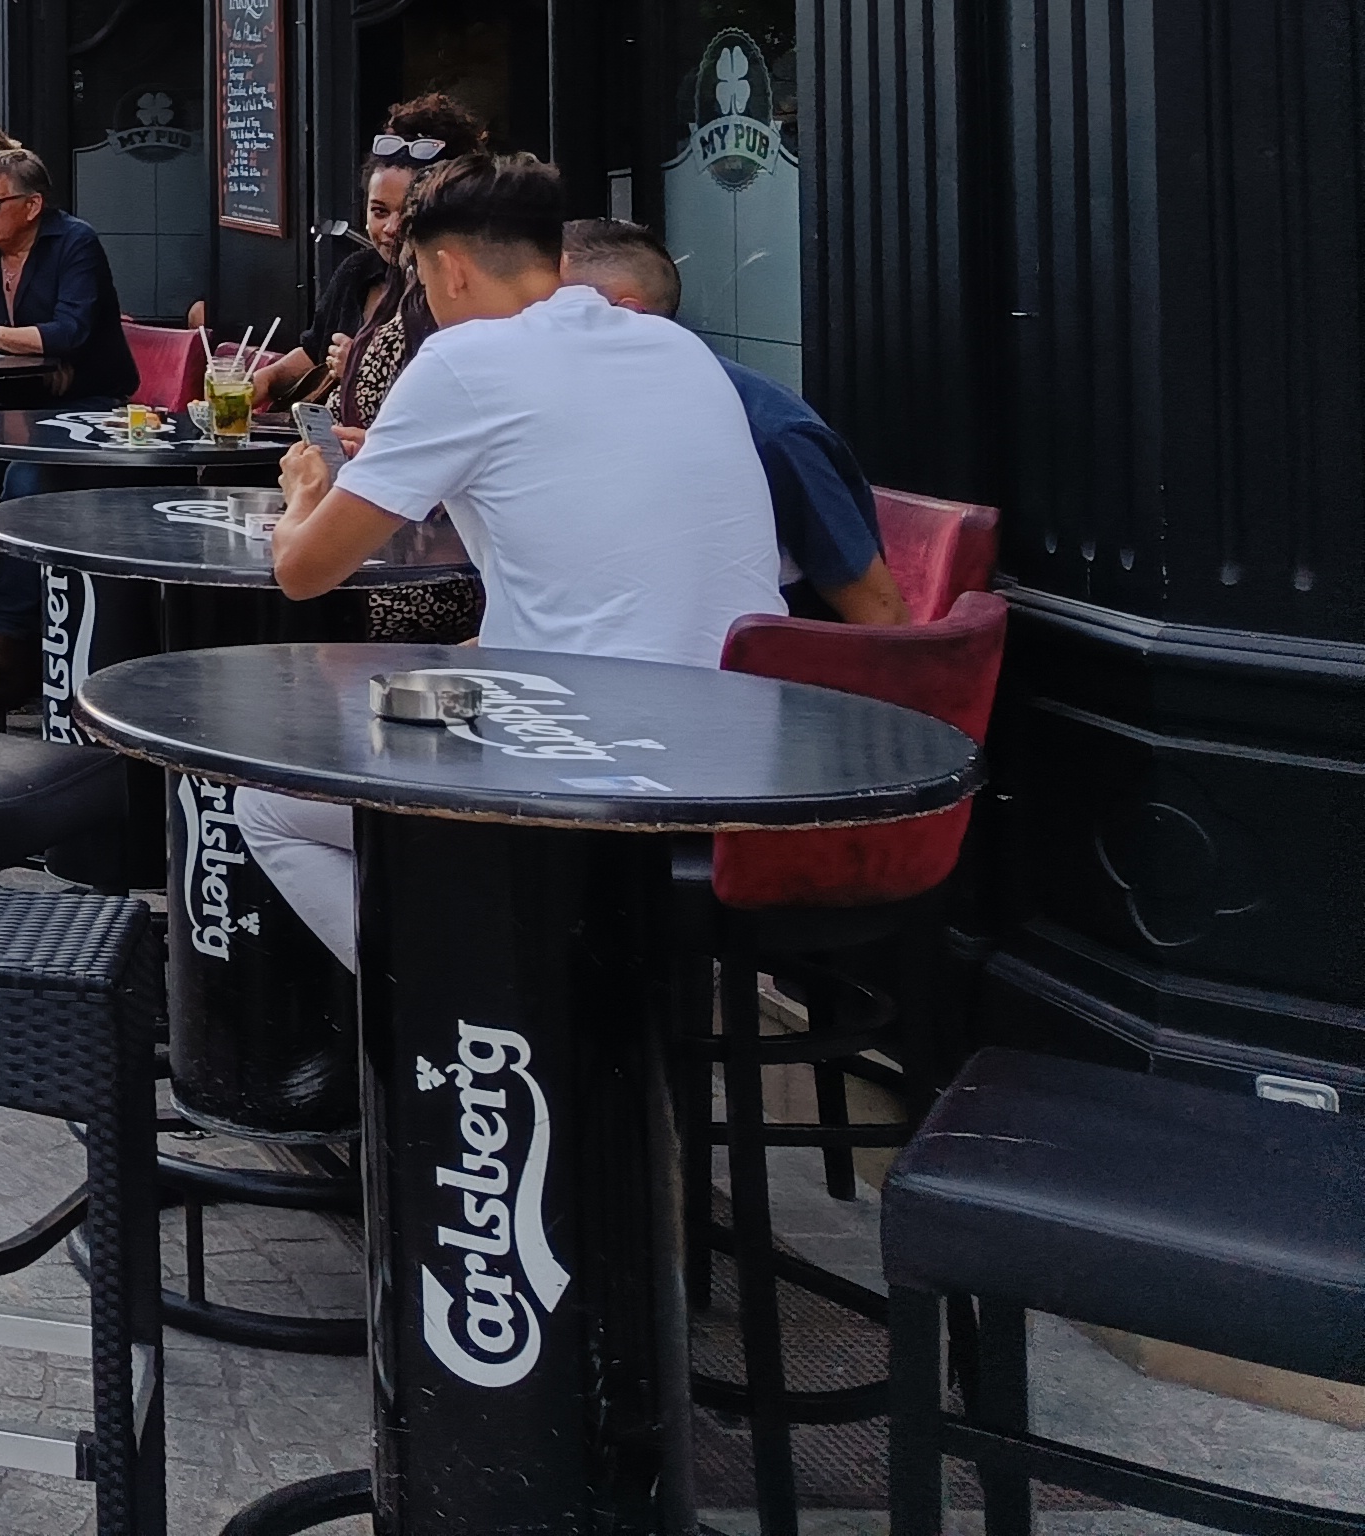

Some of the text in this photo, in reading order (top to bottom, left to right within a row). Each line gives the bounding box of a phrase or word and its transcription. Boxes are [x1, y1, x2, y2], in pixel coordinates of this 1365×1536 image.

[117, 129, 151, 149] MY
[699, 123, 770, 161] MY PUB
[421, 1018, 543, 1388] Carlsberg
